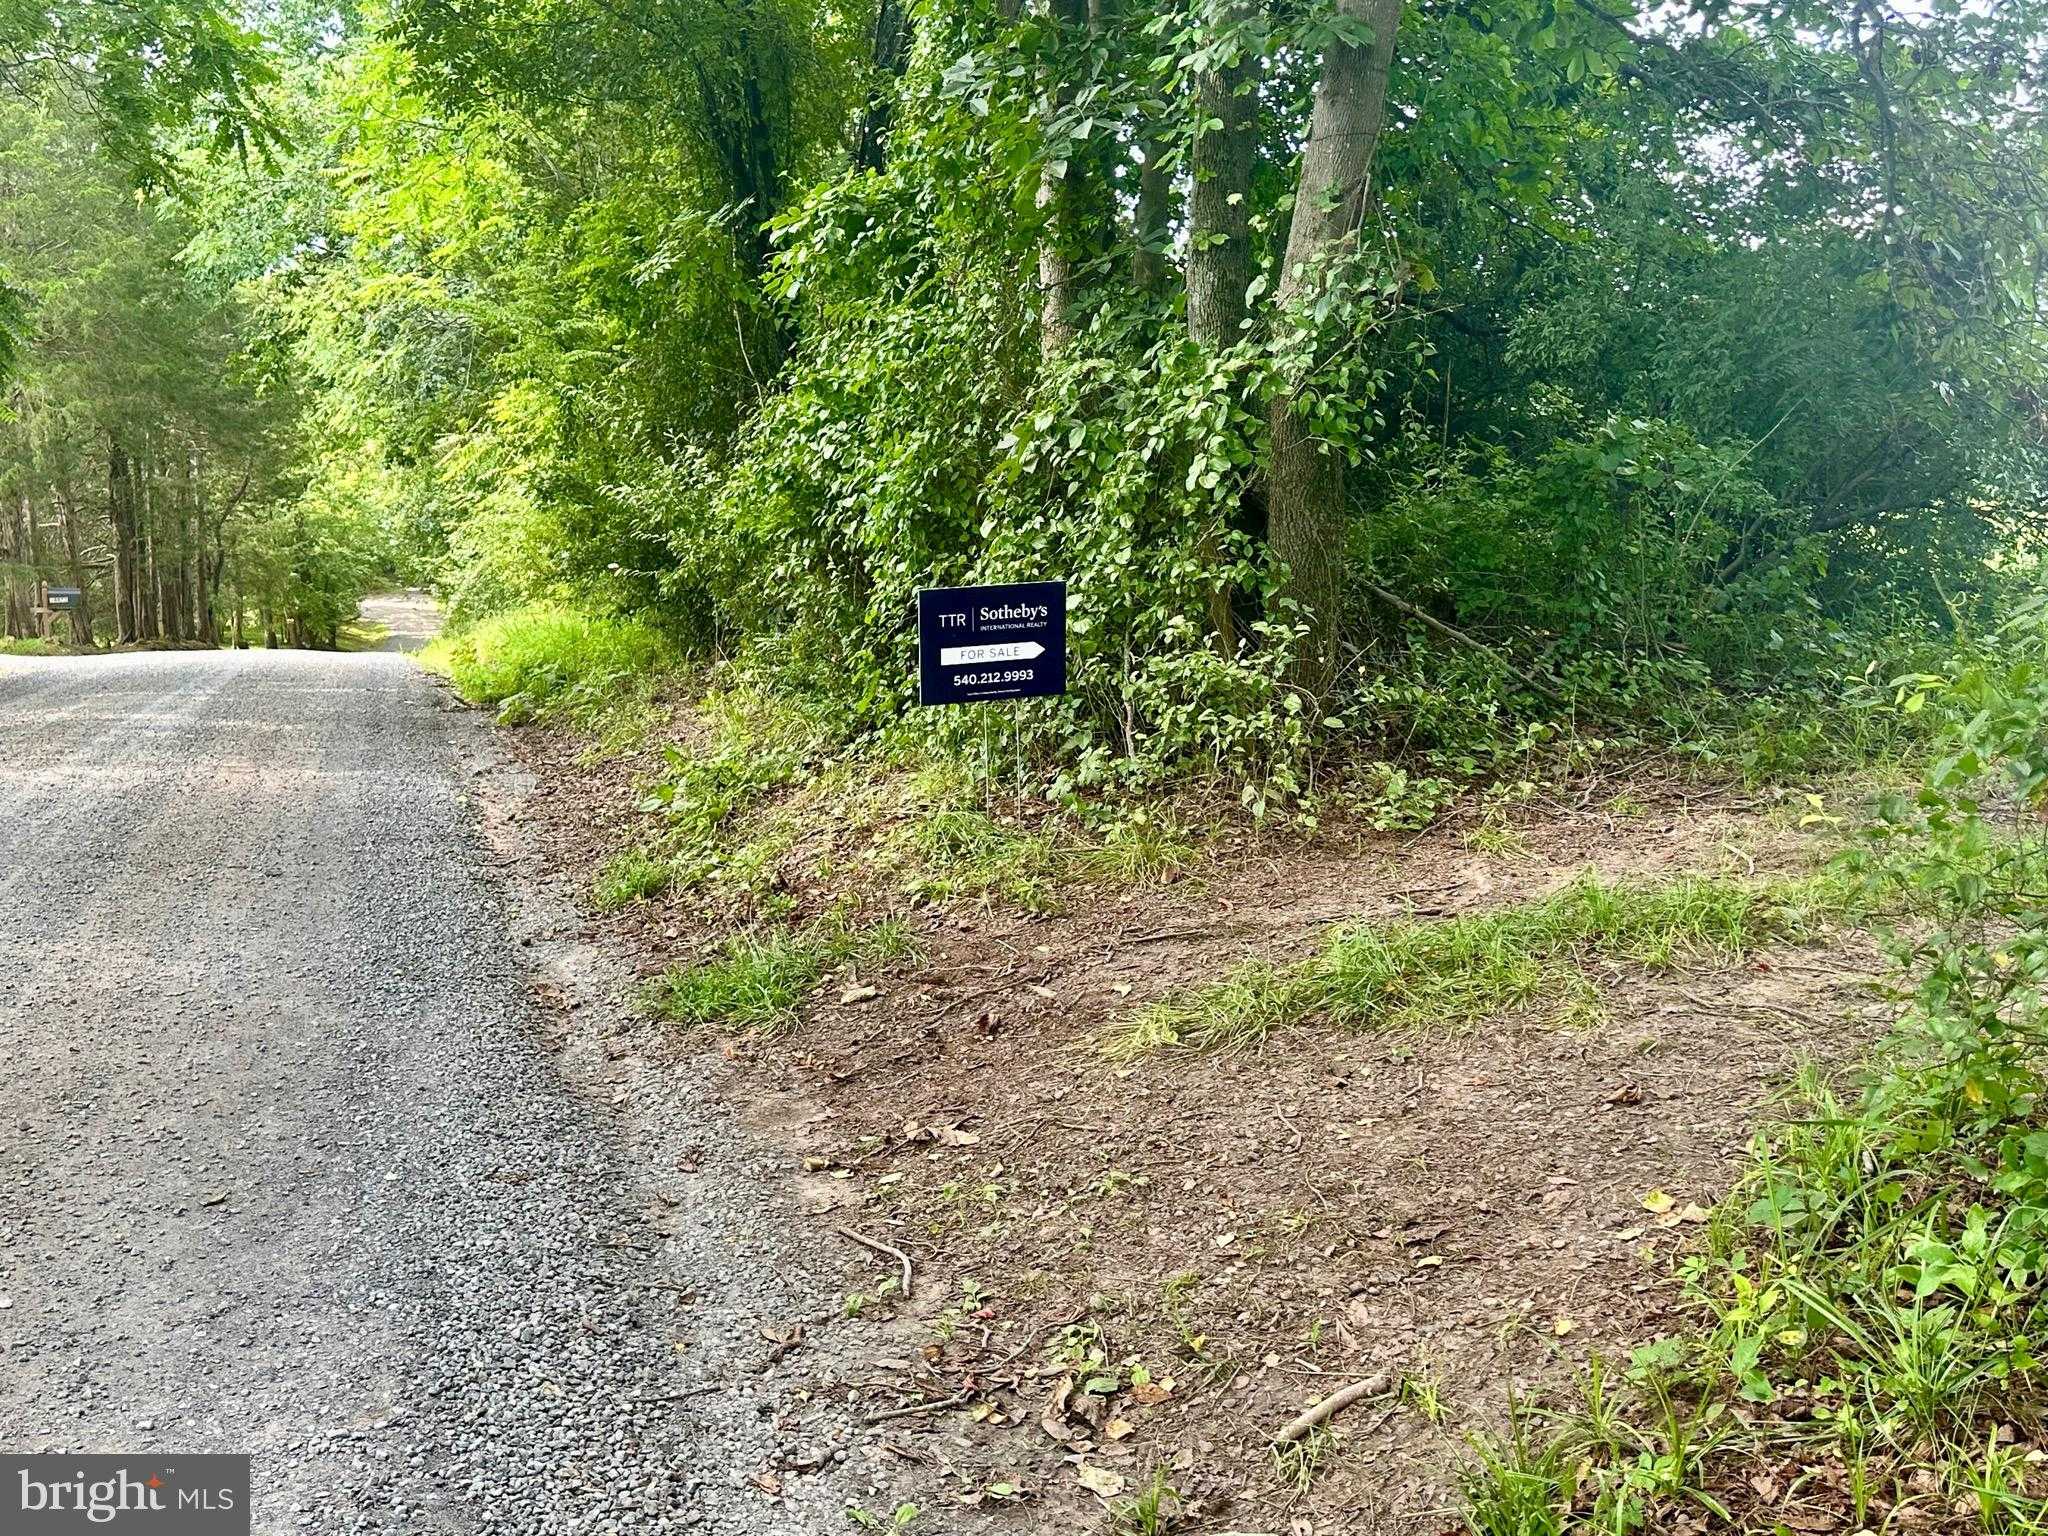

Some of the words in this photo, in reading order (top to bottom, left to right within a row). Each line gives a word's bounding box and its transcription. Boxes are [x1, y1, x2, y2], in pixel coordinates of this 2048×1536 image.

[938, 613, 966, 628] TTR
[980, 603, 1048, 621] Sotheby's
[980, 623, 1025, 631] INTERNATIONAL
[960, 649, 985, 660] FOR
[988, 646, 1021, 658] SALE
[953, 669, 1034, 686] 540.212.9993
